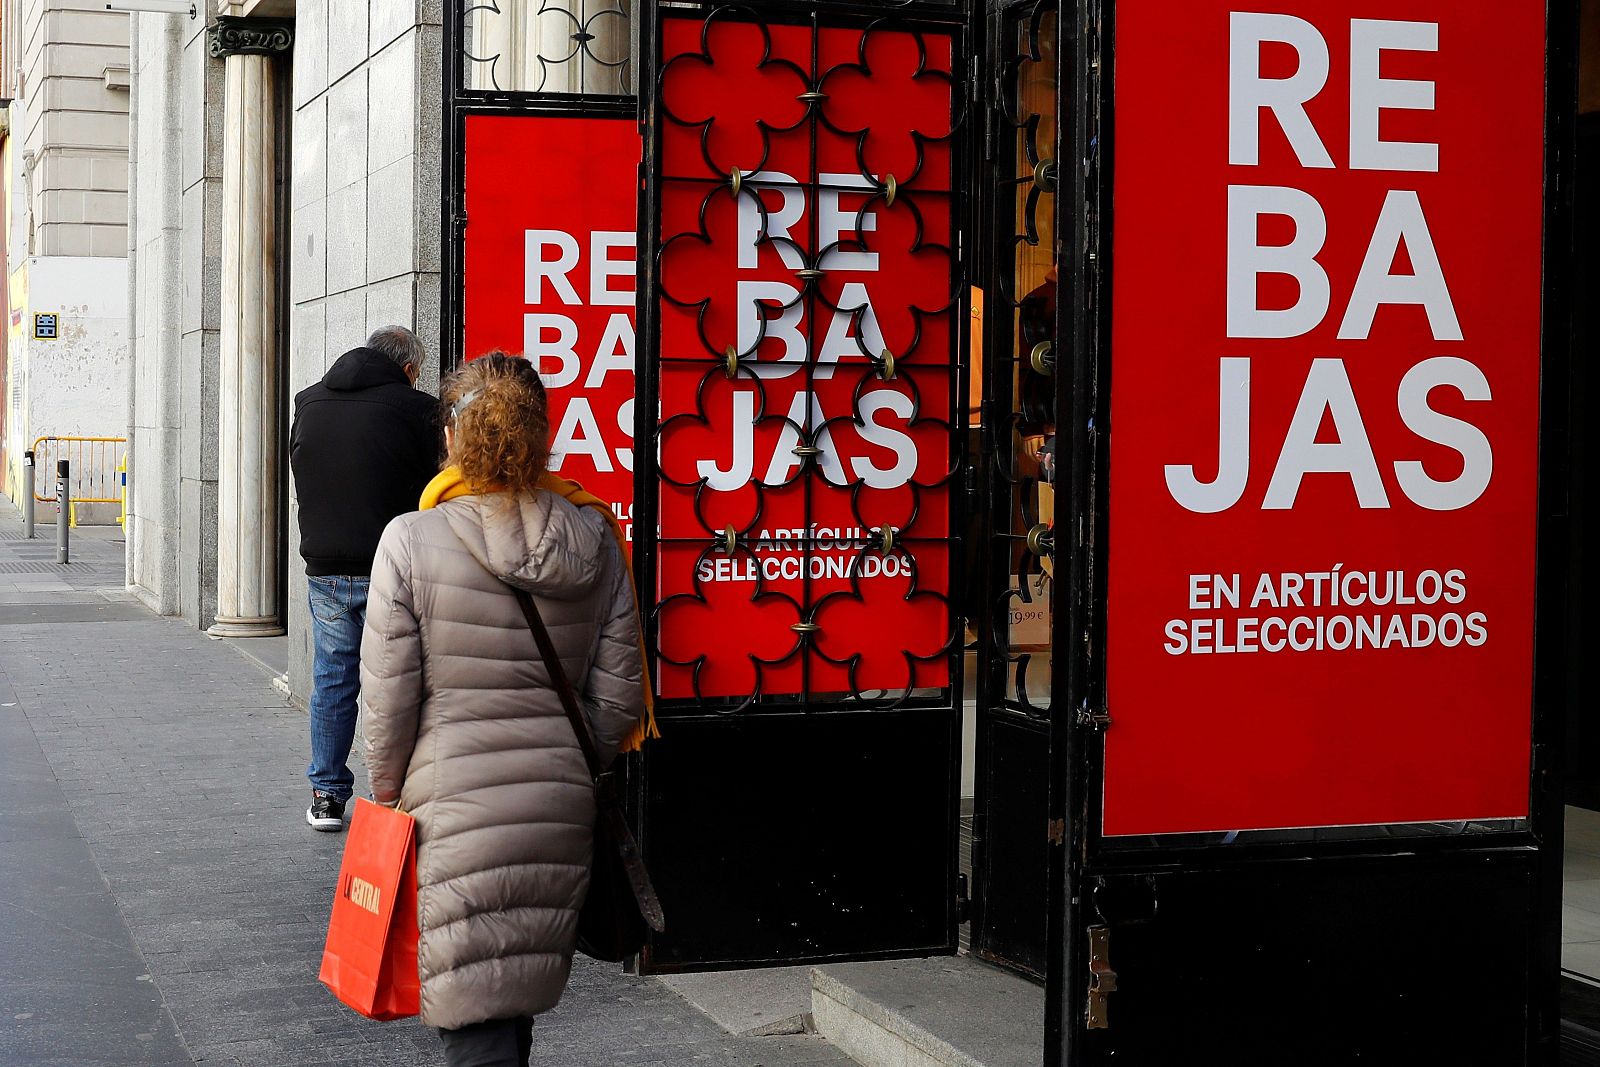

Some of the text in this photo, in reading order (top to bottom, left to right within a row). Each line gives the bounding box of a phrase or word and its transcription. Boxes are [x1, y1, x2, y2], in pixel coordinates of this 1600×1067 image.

[1228, 11, 1440, 173] RE
[737, 170, 881, 272] RE
[524, 229, 637, 307] RE
[1226, 185, 1464, 341] BA
[523, 313, 636, 389] BA
[737, 280, 896, 380] BA
[696, 389, 919, 492] JAS
[1164, 356, 1493, 514] JAS
[697, 553, 916, 583] SELECCIONADOS
[755, 522, 900, 552] ARTÍCUL
[1189, 563, 1467, 610] EN ARTÍCULOS
[1164, 611, 1489, 656] SELECCIONADOS
[352, 877, 380, 915] CENTRAL
